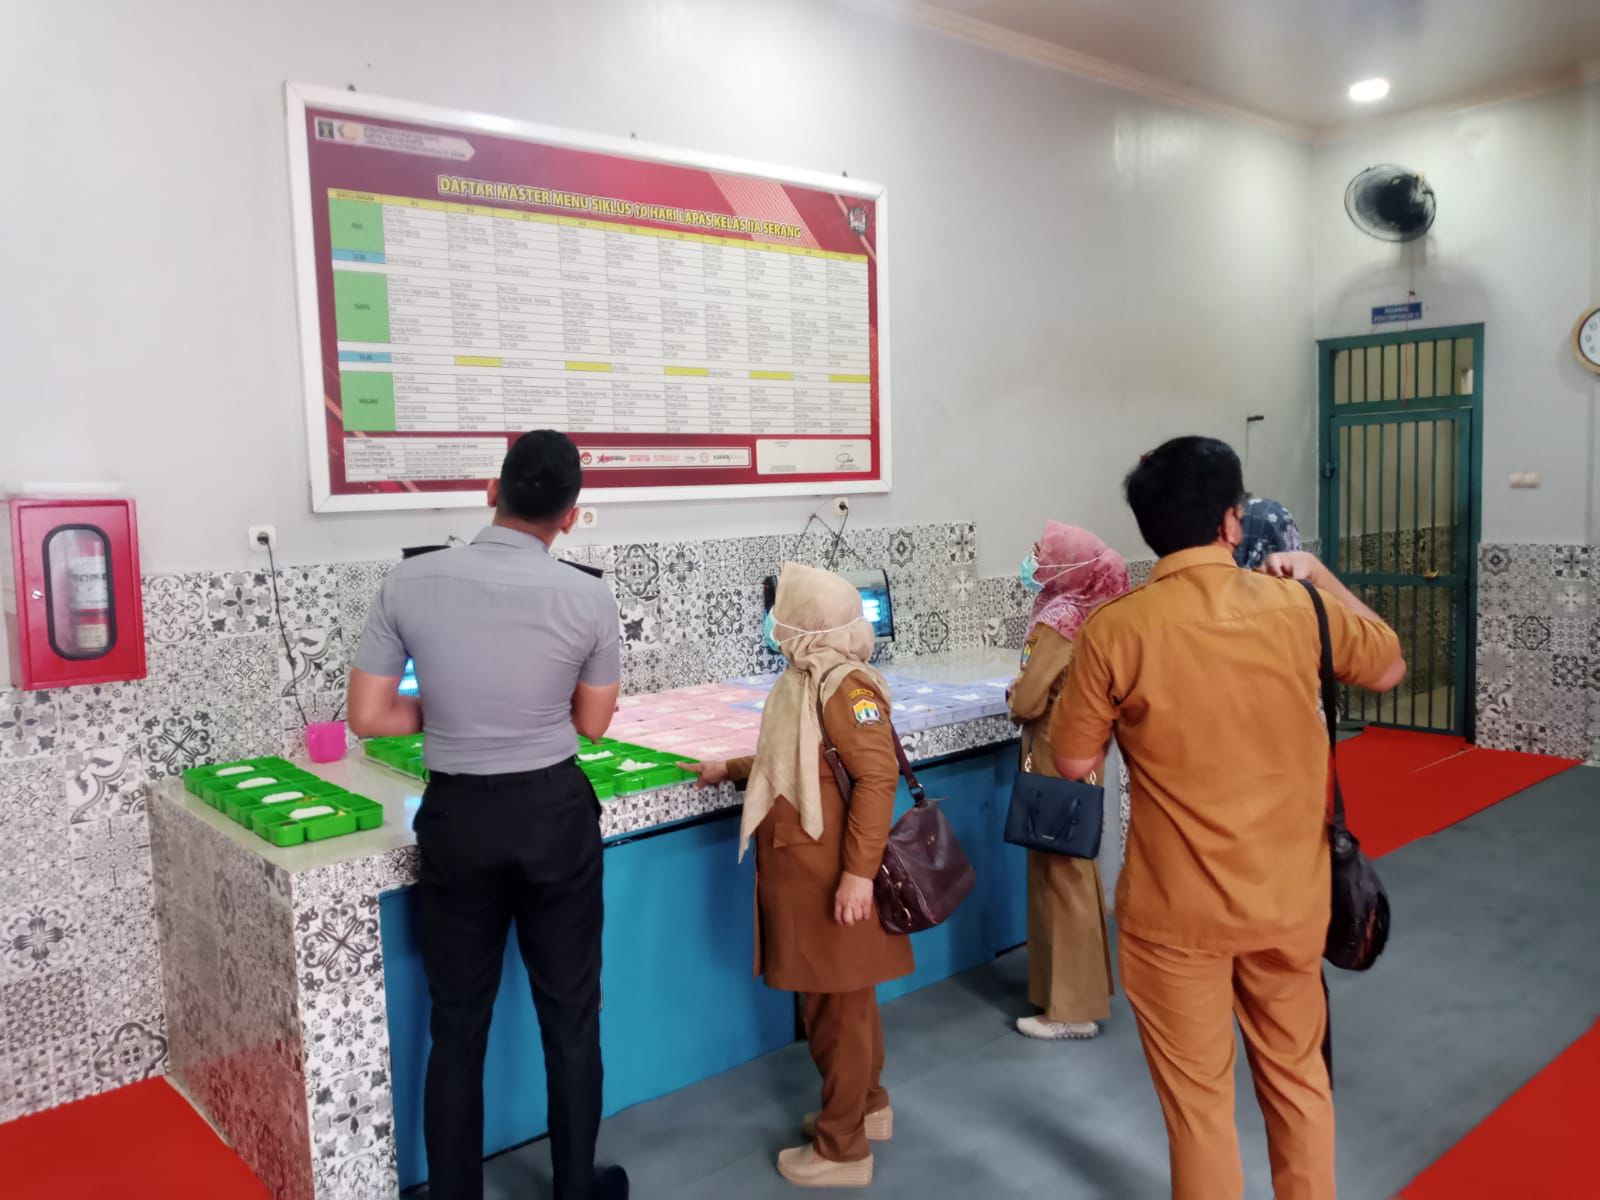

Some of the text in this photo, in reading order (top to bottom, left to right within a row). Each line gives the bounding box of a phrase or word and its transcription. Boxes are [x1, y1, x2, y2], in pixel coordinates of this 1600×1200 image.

[438, 175, 495, 198] DAFTAR
[496, 183, 550, 205] MASTER
[551, 191, 589, 210] MENU
[590, 197, 632, 216] SIKLUS
[649, 204, 678, 223] HARI
[678, 208, 712, 227] LAPAS
[713, 214, 747, 232] KELAS
[748, 218, 762, 234] IIA
[762, 221, 802, 239] SERANG
